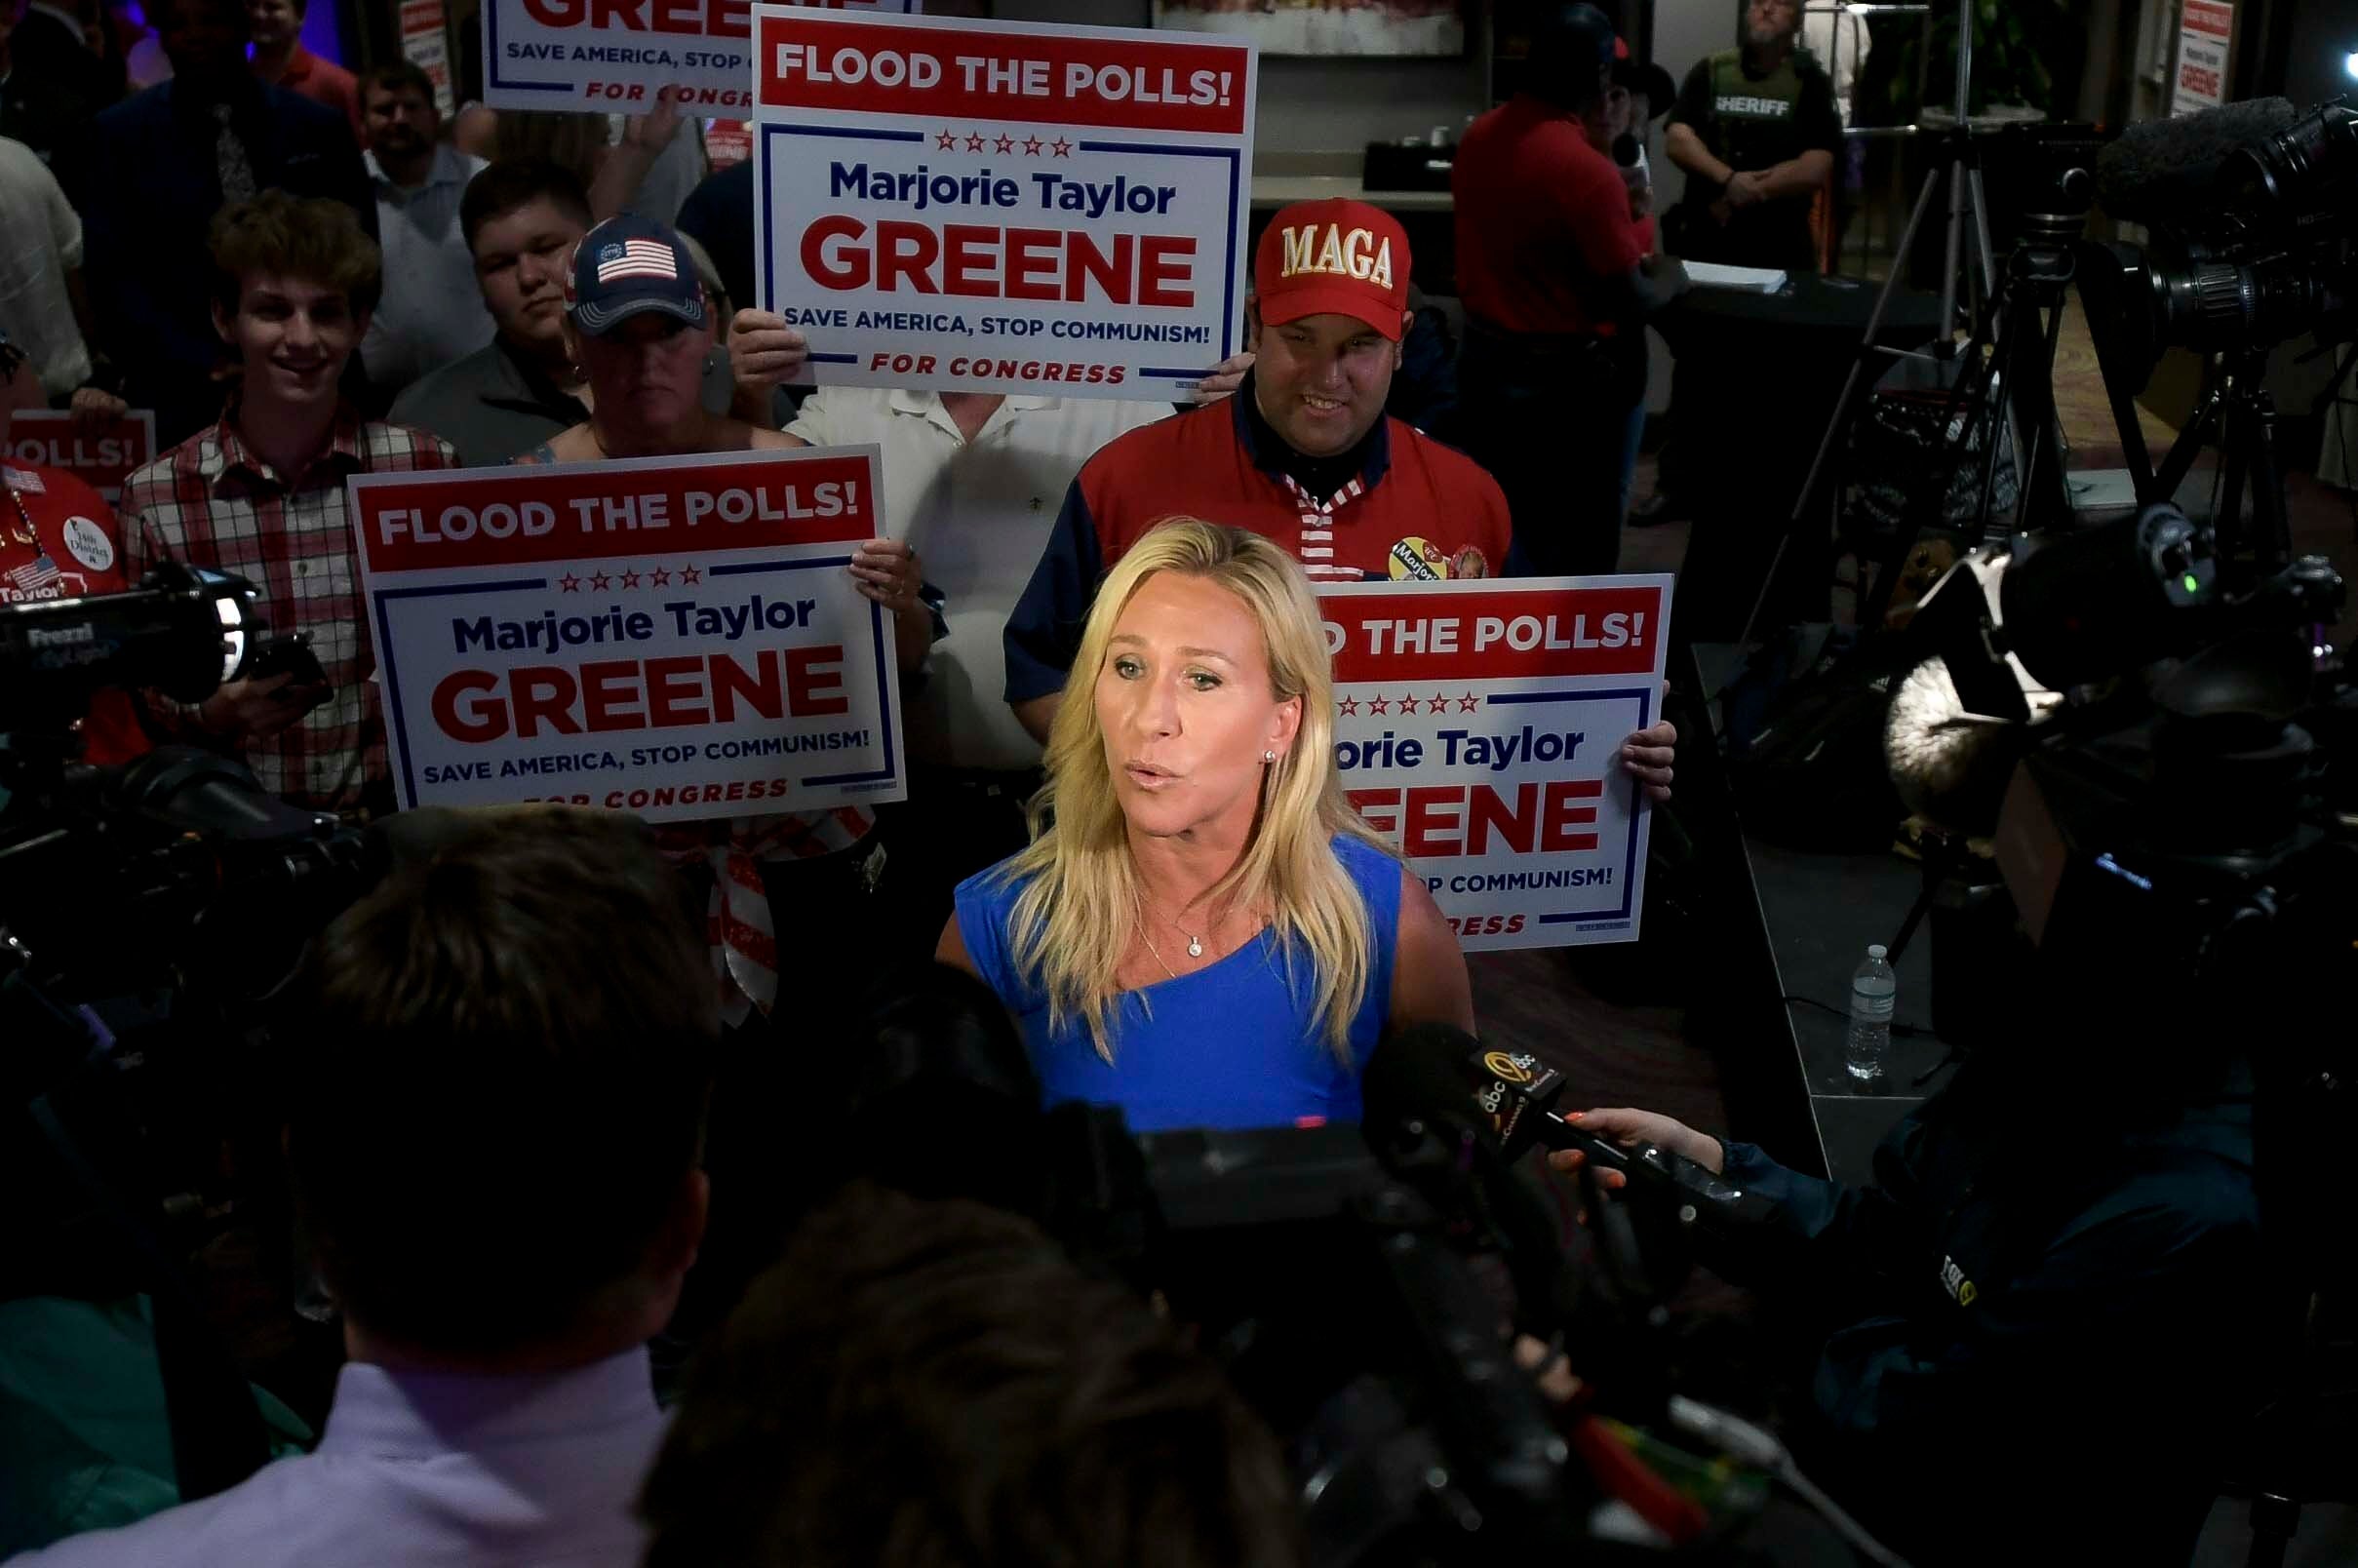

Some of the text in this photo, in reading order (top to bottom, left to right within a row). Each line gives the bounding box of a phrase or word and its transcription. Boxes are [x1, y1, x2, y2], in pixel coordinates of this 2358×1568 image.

[507, 43, 566, 61] SAVE
[572, 47, 680, 69] AMERICA,
[685, 52, 742, 69] STOP
[775, 43, 1233, 106] FLOOD THE POLLS!
[585, 82, 645, 100] FOR
[1715, 96, 1790, 117] SHERIFF
[829, 161, 1176, 219] Marjorie Taylor
[799, 214, 1199, 308] GREENE
[1280, 222, 1394, 291] MAGA
[784, 307, 1210, 344] SAVE AMERICA, STOP COMMUNISM!
[870, 353, 1127, 385] FOR CONGRESS
[377, 481, 859, 546] FLOOD THE POLLS!
[452, 594, 816, 654] Marjorie Taylor
[1361, 617, 1460, 655] THE
[1474, 611, 1645, 653] POLLS!
[430, 644, 849, 744] GREENE
[424, 729, 870, 785] SAVE AMERICA, STOP COMMUNISM!
[1436, 725, 1585, 771] Taylor
[605, 778, 788, 809] CONGRESS
[1343, 779, 1604, 858] EENE
[1450, 867, 1613, 894] COMMUNISM!
[1483, 1080, 1507, 1114] abc
